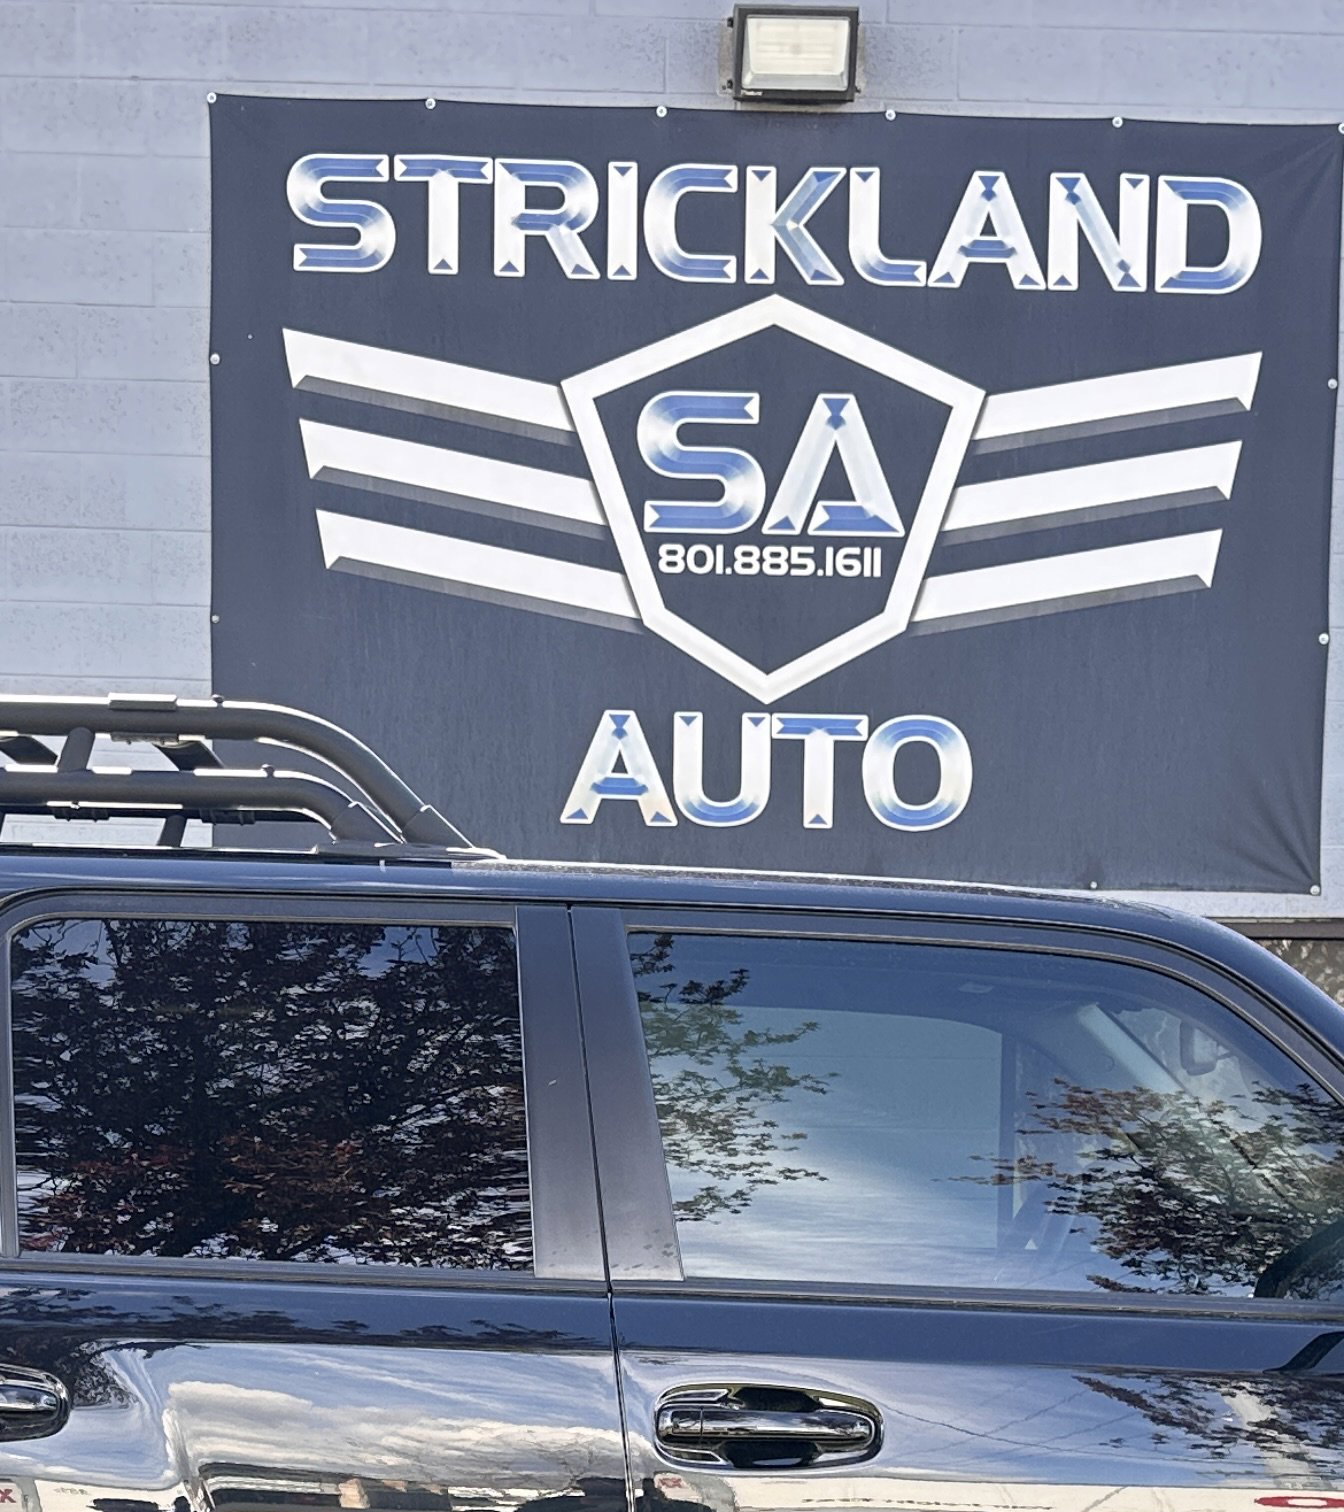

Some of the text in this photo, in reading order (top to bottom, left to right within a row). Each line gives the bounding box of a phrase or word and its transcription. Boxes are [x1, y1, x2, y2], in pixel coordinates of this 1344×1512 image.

[286, 152, 1262, 294] STRICKLAND
[636, 390, 905, 537] SA
[657, 541, 883, 579] 801.885.1611
[560, 709, 973, 833] AUTO
